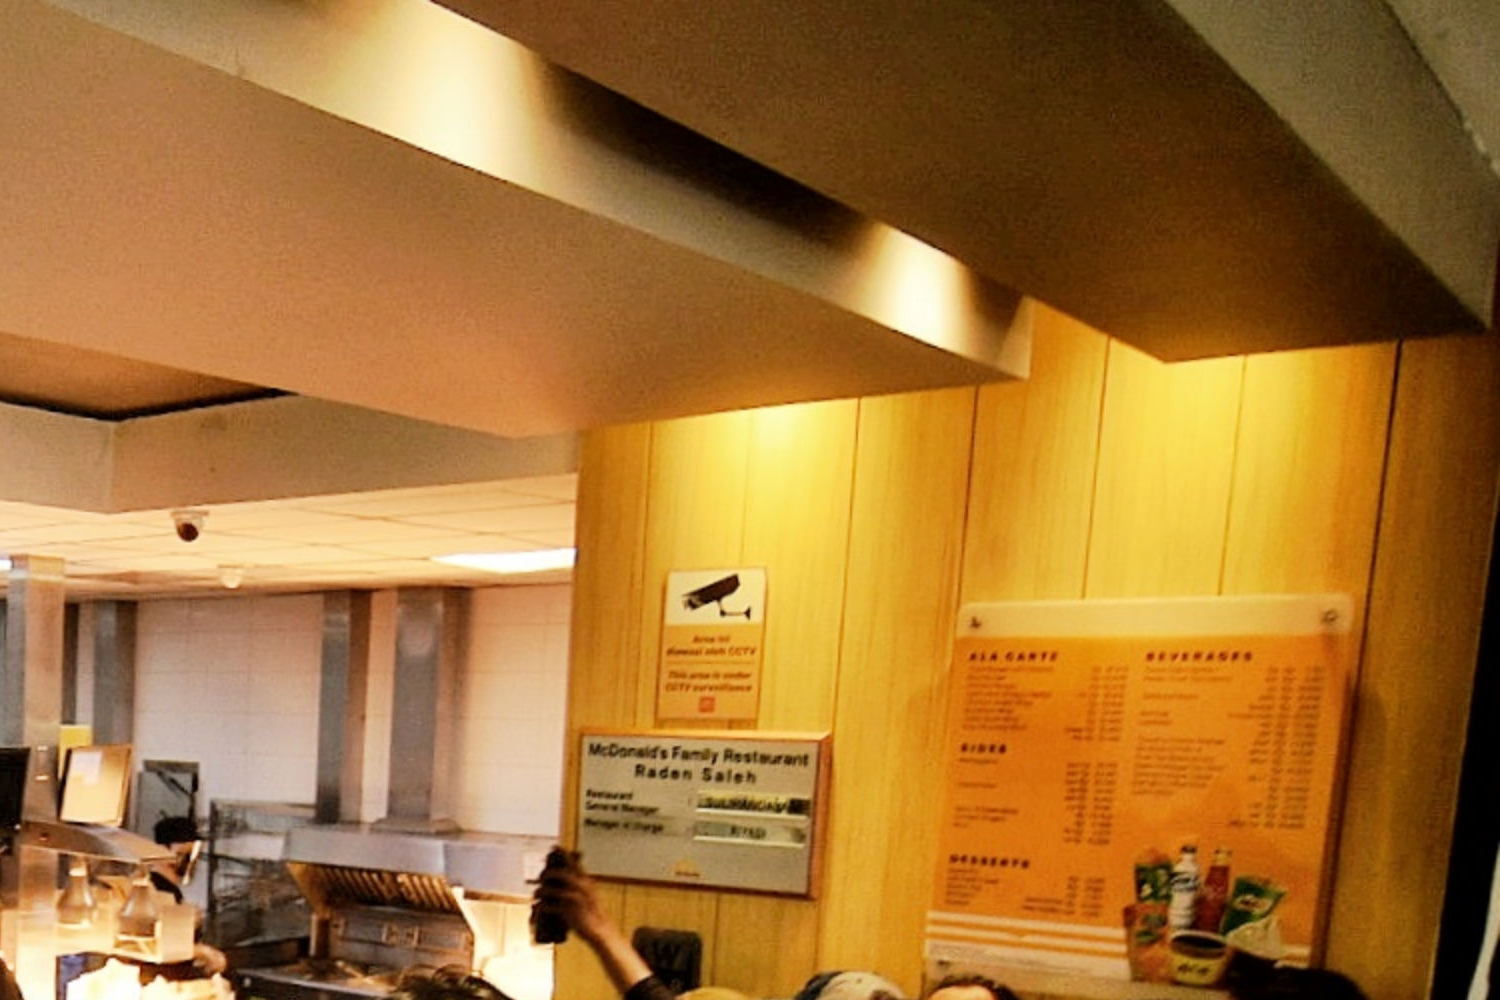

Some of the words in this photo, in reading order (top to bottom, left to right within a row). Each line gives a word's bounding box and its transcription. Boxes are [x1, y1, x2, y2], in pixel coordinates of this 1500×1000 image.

[588, 743, 668, 760] McDonald's
[672, 746, 719, 765] Family
[723, 749, 810, 767] Restaurant
[634, 764, 693, 780] Raden
[702, 767, 757, 784] Saleh
